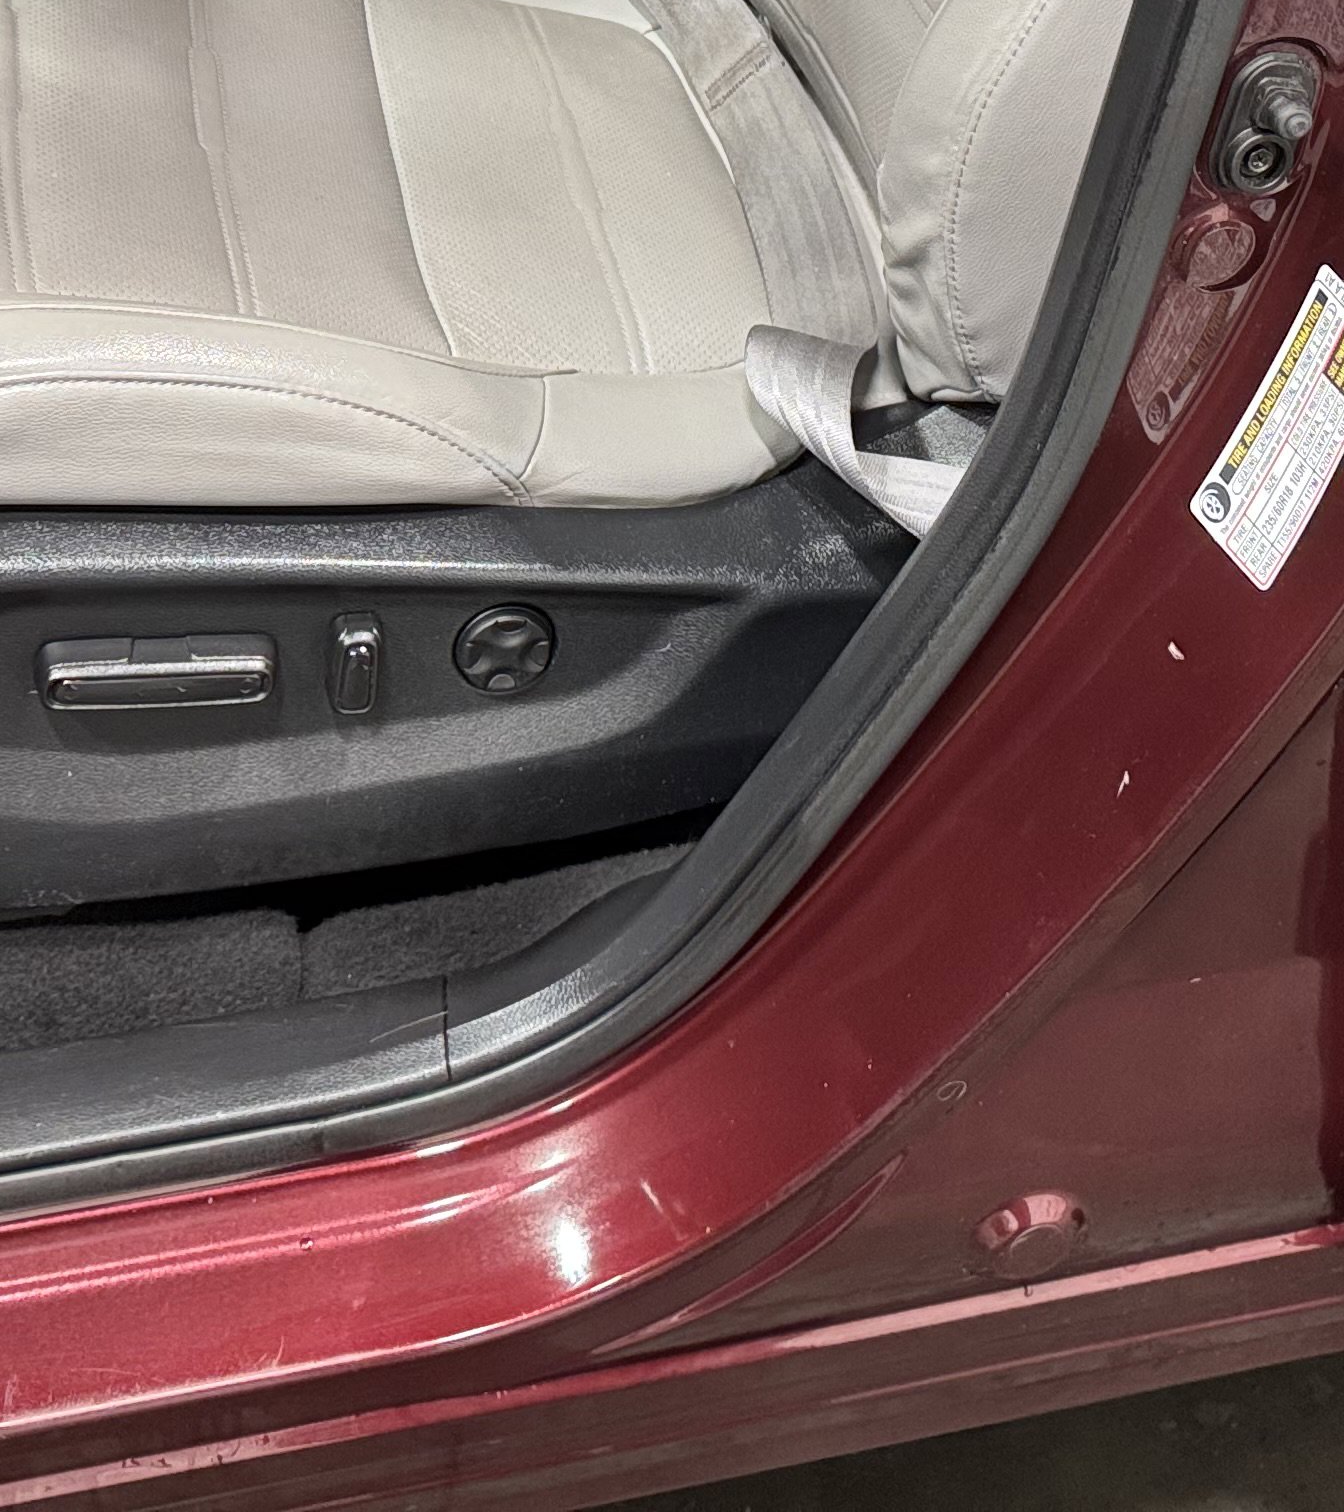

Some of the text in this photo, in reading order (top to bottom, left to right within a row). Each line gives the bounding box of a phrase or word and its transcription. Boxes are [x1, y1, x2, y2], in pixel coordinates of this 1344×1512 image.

[1227, 298, 1323, 471] TIRE AND LOADING INFORMATION
[1326, 359, 1339, 379] SEE
[1232, 523, 1248, 544] TIRE
[1263, 471, 1278, 493] SIZE
[1239, 529, 1258, 558] FRONT
[1261, 483, 1293, 535] 235/60R18
[1289, 460, 1307, 487] 103H
[1250, 540, 1267, 567] REAR
[1328, 397, 1344, 427] 30PSI
[1258, 550, 1278, 579] SPARE
[1304, 476, 1319, 500] 112M
